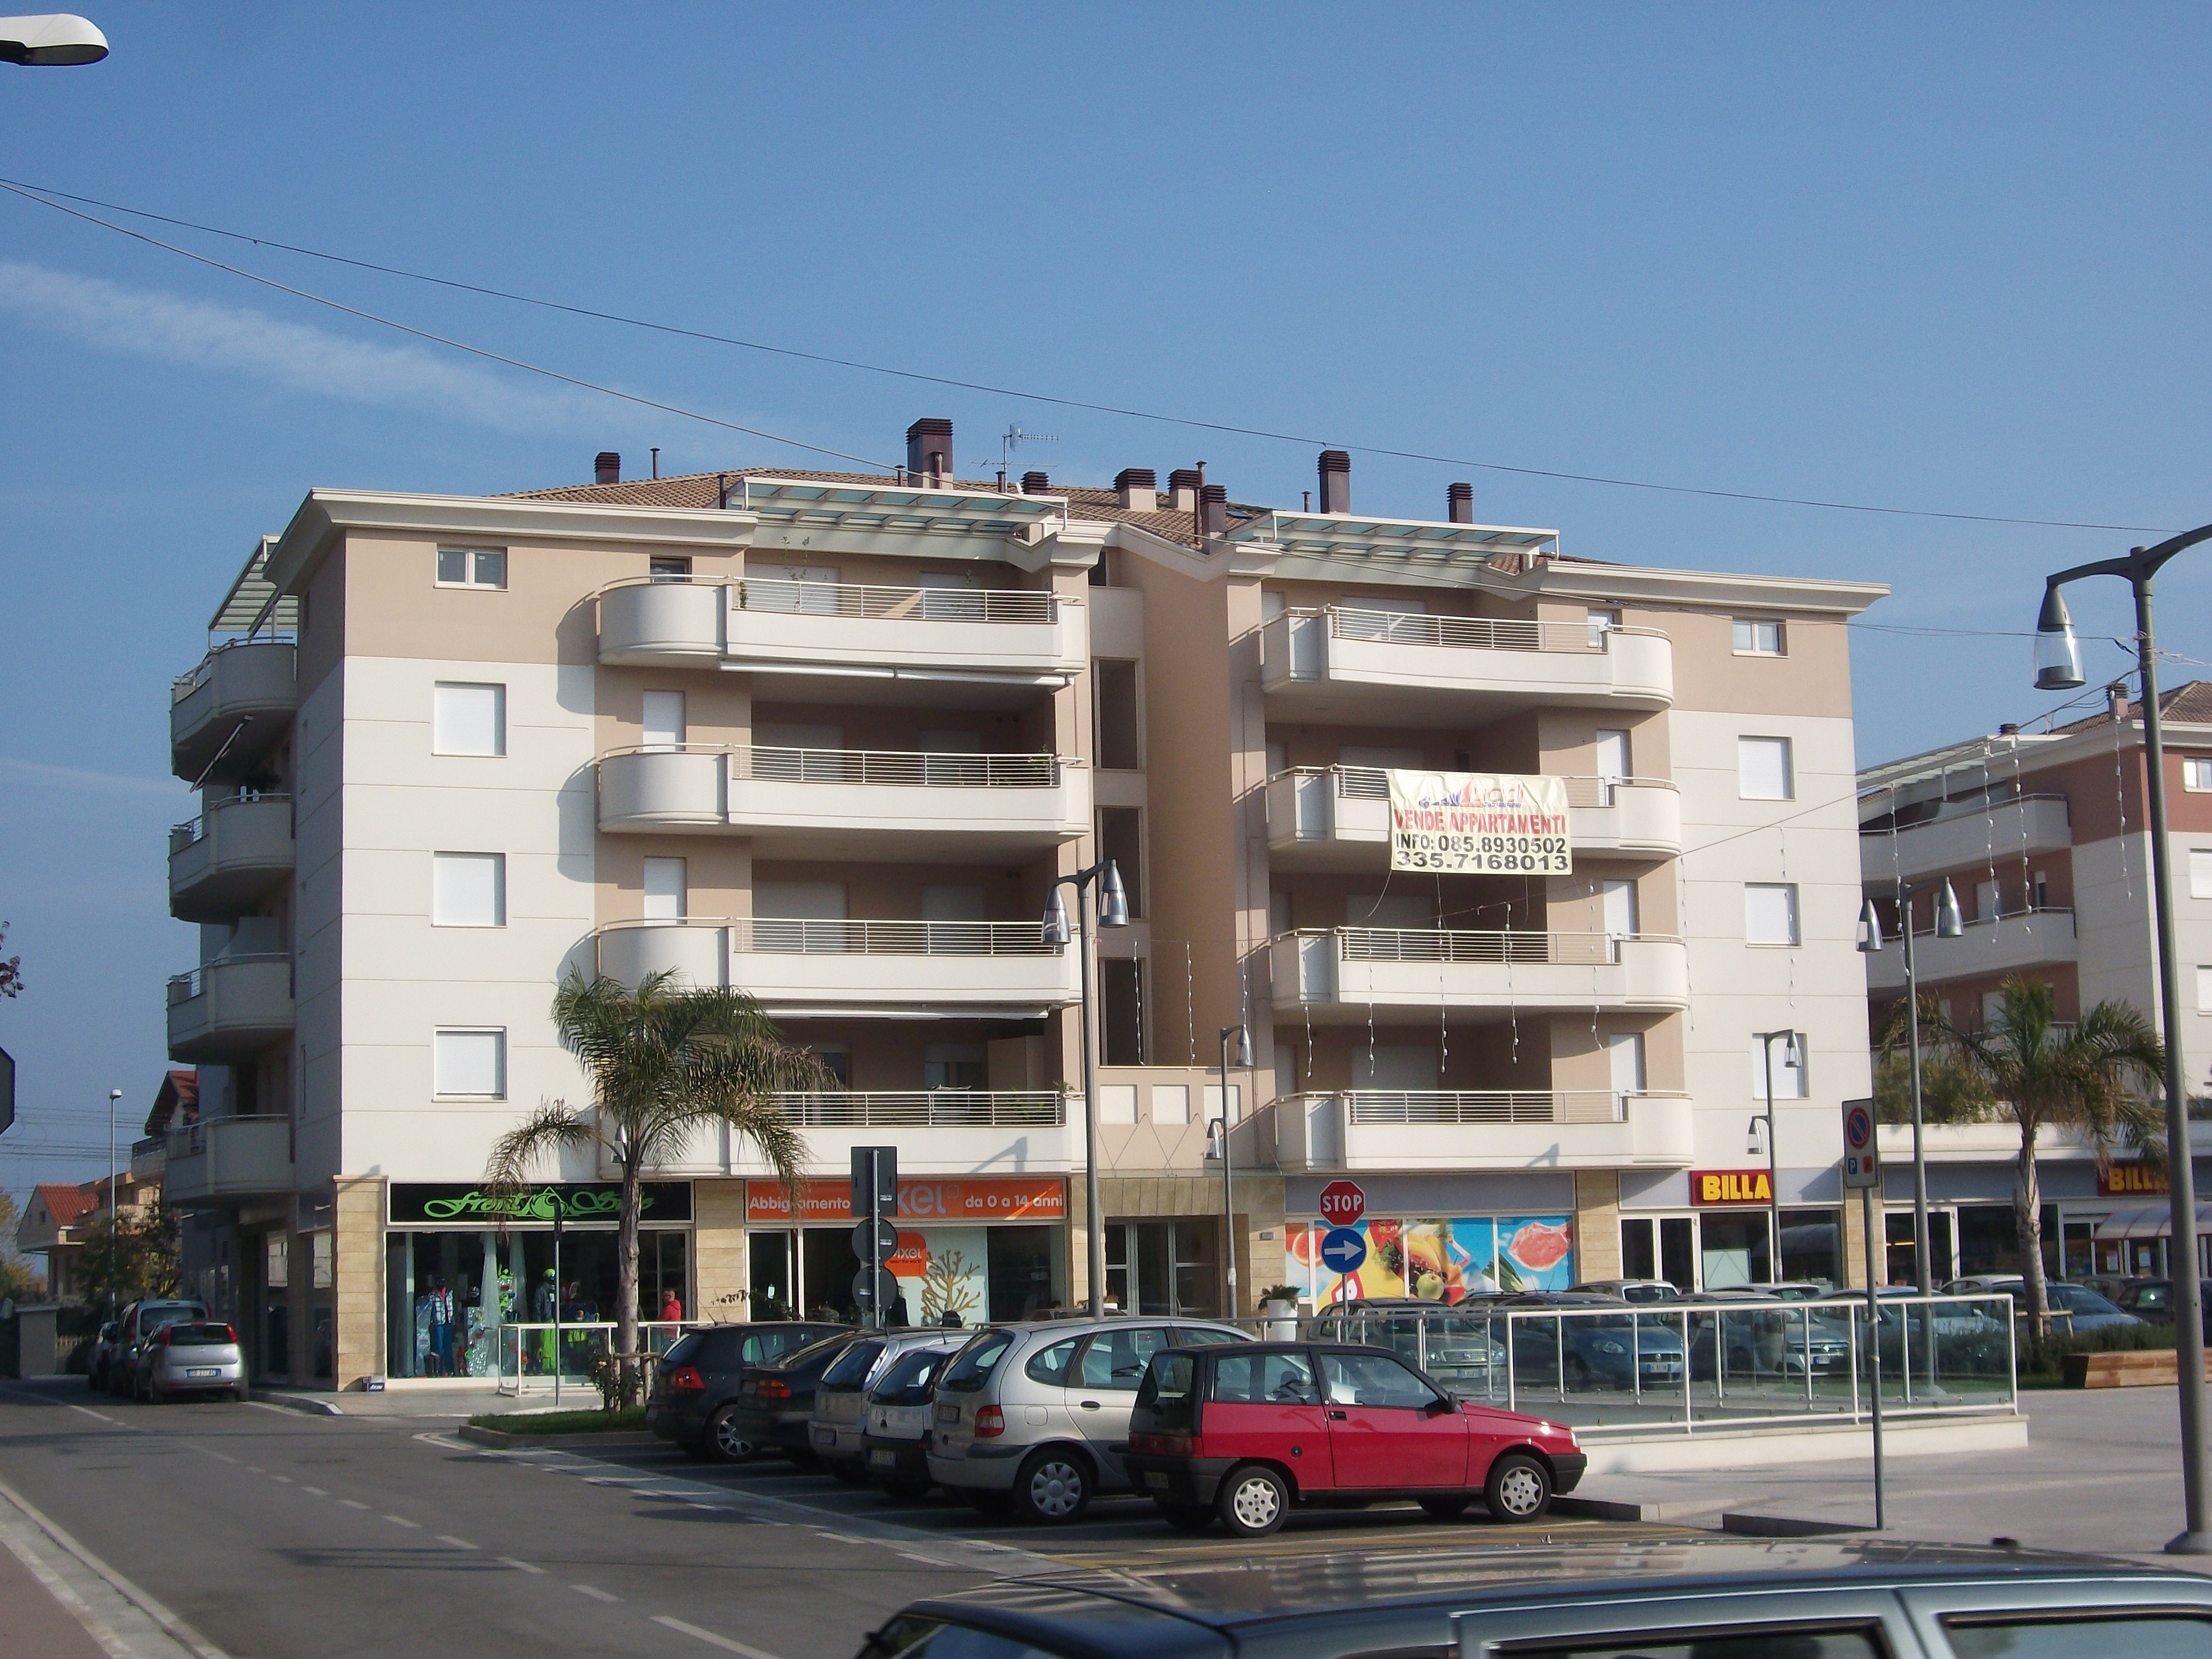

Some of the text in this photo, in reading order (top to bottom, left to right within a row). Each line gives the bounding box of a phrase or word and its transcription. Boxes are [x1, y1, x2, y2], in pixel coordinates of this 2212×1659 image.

[1394, 809, 1566, 834] VENDE APPARTAMENTI
[1396, 833, 1567, 854] INFO: 085.8930502
[1396, 851, 1568, 870] 335.7168013
[1703, 1174, 1771, 1201] BILLA
[749, 1196, 851, 1213] Abbigamento
[965, 1195, 983, 1208] da
[1001, 1197, 1011, 1207] a
[1014, 1195, 1028, 1207] 14
[1032, 1194, 1063, 1207] anni
[1322, 1194, 1363, 1212] STOP
